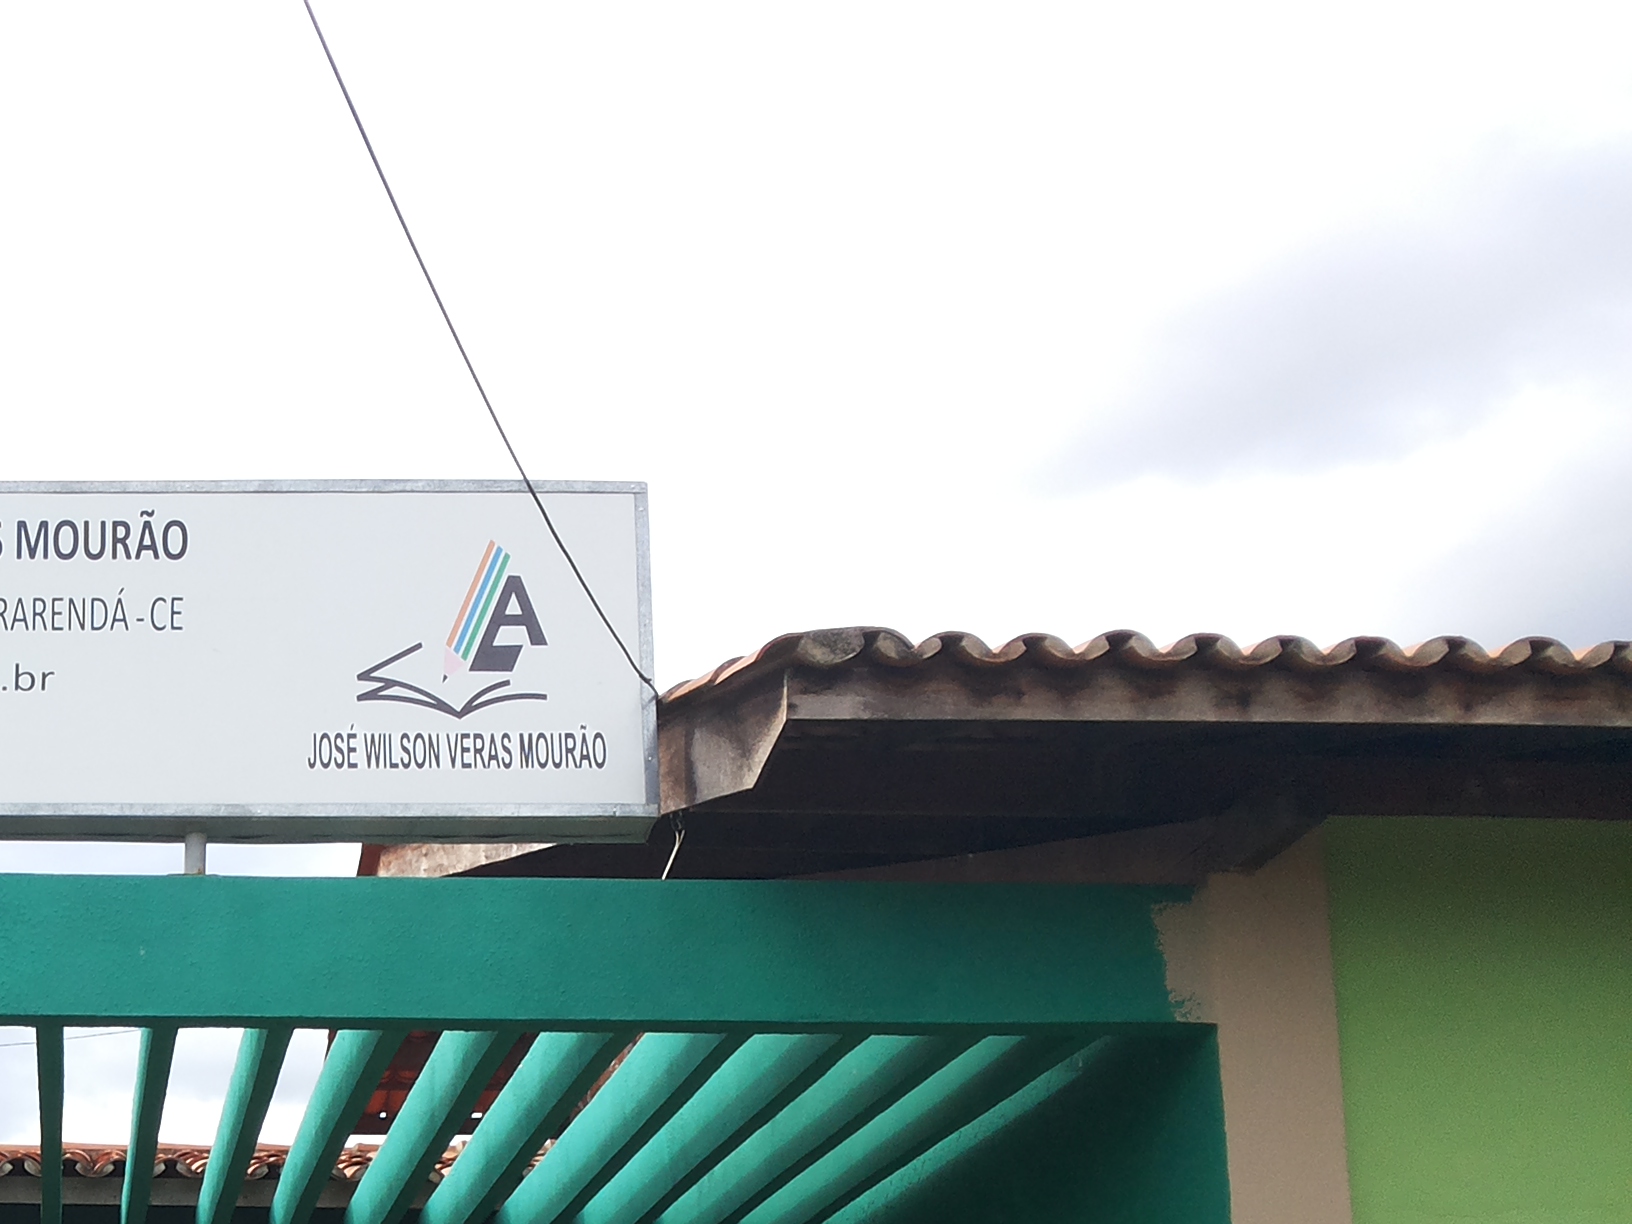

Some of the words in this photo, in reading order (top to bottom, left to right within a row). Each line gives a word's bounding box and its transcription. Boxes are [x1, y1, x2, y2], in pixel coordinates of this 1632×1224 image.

[16, 509, 188, 561] MOURÃO
[308, 723, 359, 770] JOSÉ
[363, 732, 441, 770] WILSON
[445, 732, 512, 770] VERAS
[519, 724, 607, 770] MOURÃO
